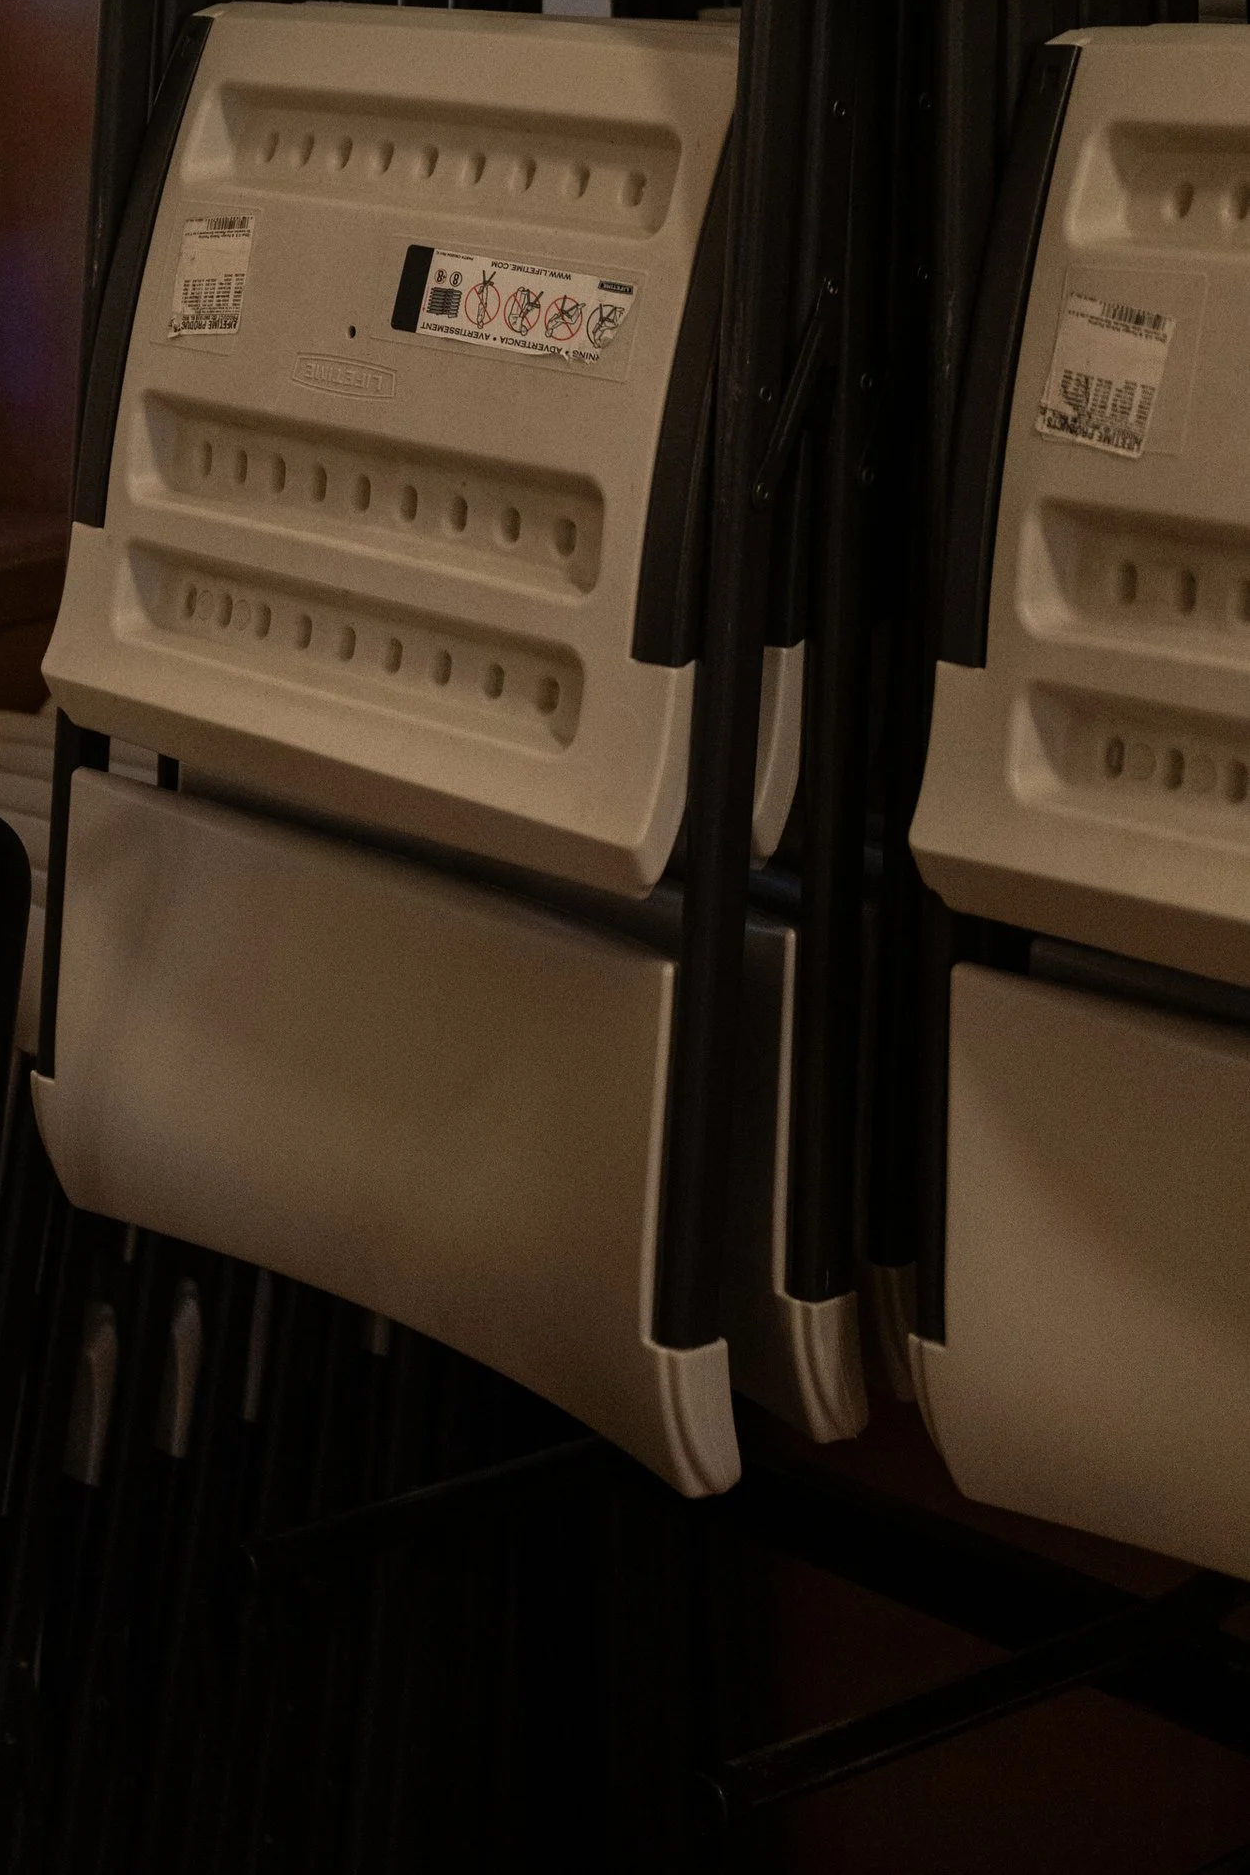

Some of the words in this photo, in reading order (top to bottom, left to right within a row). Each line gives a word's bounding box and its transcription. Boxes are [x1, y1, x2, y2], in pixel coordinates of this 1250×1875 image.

[452, 273, 460, 285] 8
[490, 260, 571, 281] WWW.LIFETIME.COM
[603, 283, 630, 293] LIFETIME
[208, 319, 238, 330] LIFETIME
[419, 321, 491, 341] AVERTISSEMENT
[500, 335, 563, 355] ADVERTENCIA
[304, 363, 383, 392] LIFETIME
